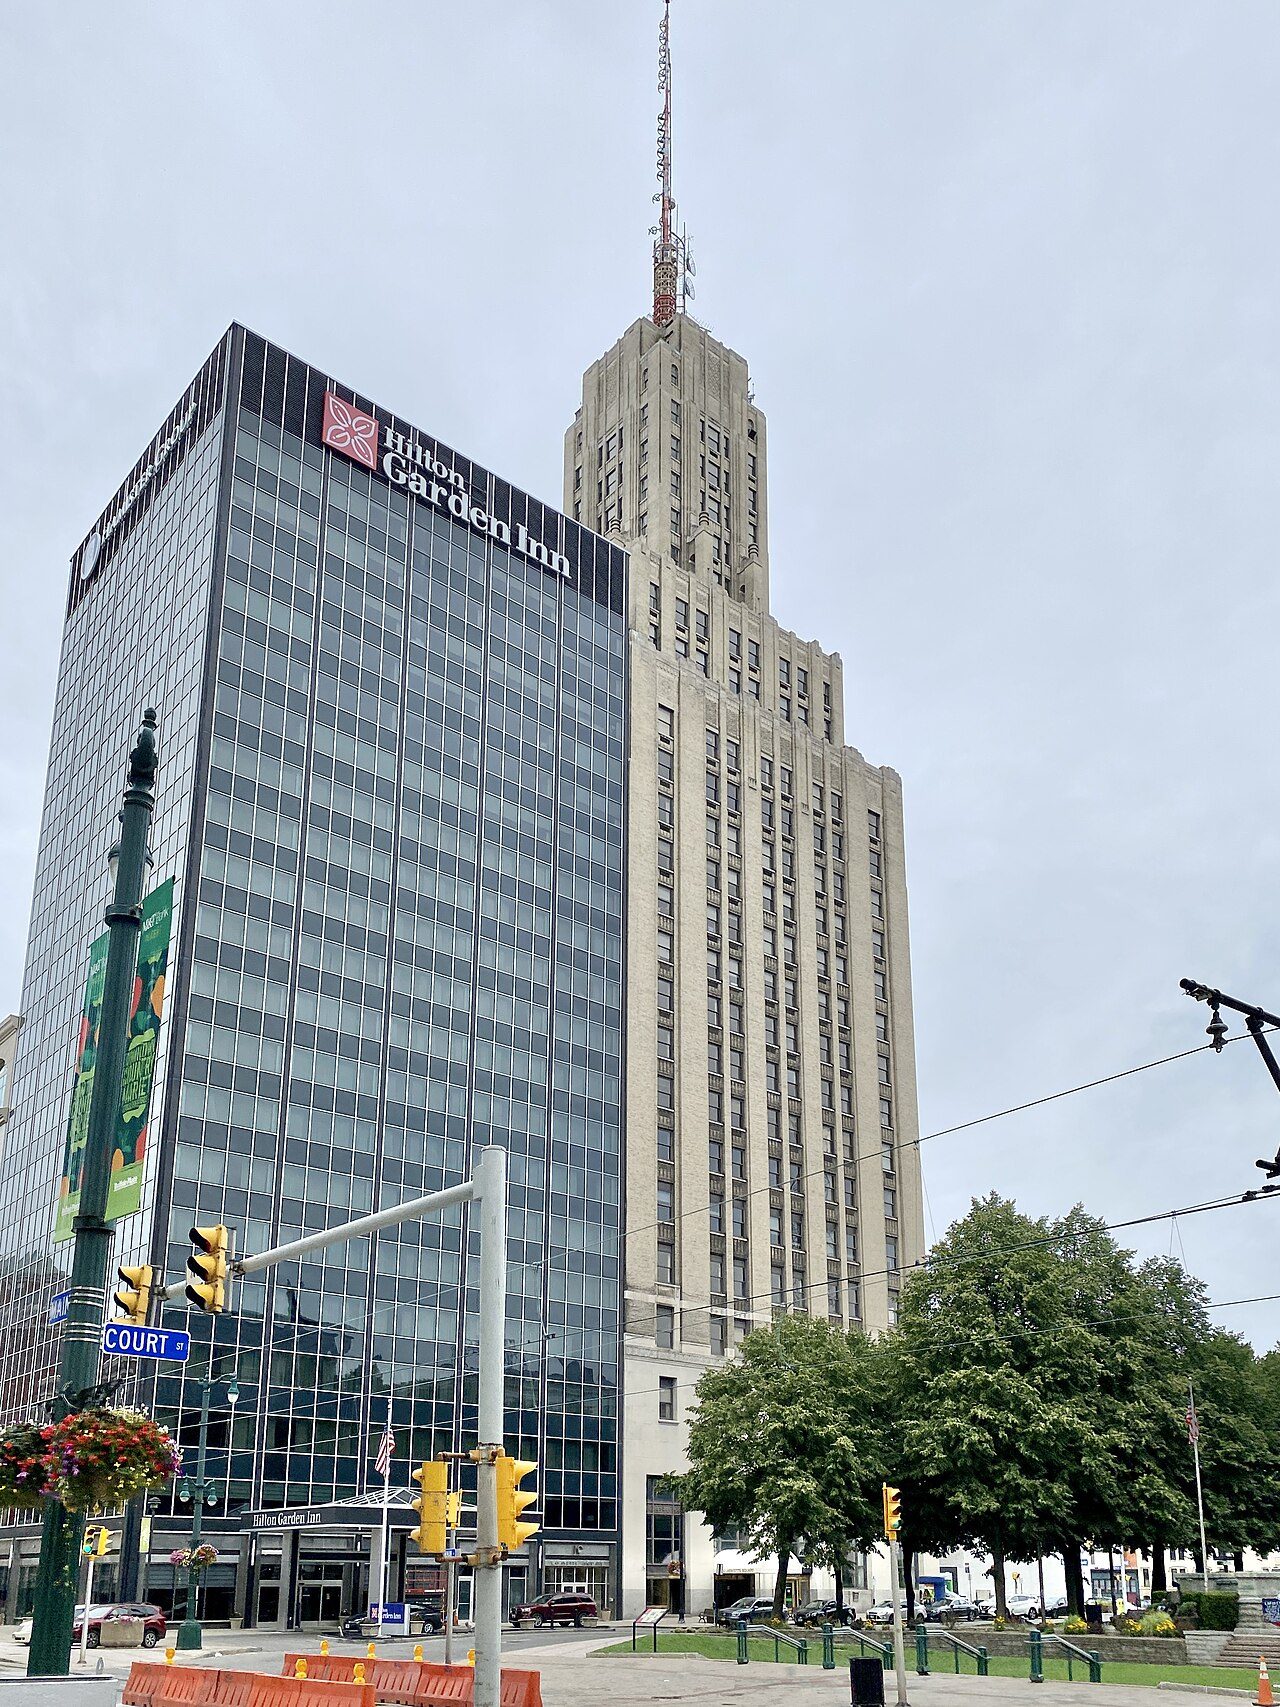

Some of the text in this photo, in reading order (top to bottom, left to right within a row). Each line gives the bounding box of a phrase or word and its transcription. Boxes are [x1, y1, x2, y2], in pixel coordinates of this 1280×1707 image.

[383, 425, 466, 491] Hilton
[383, 452, 572, 579] Garden Inn
[105, 1328, 184, 1354] COURT ST
[253, 1510, 321, 1527] Hilton Garden Inn
